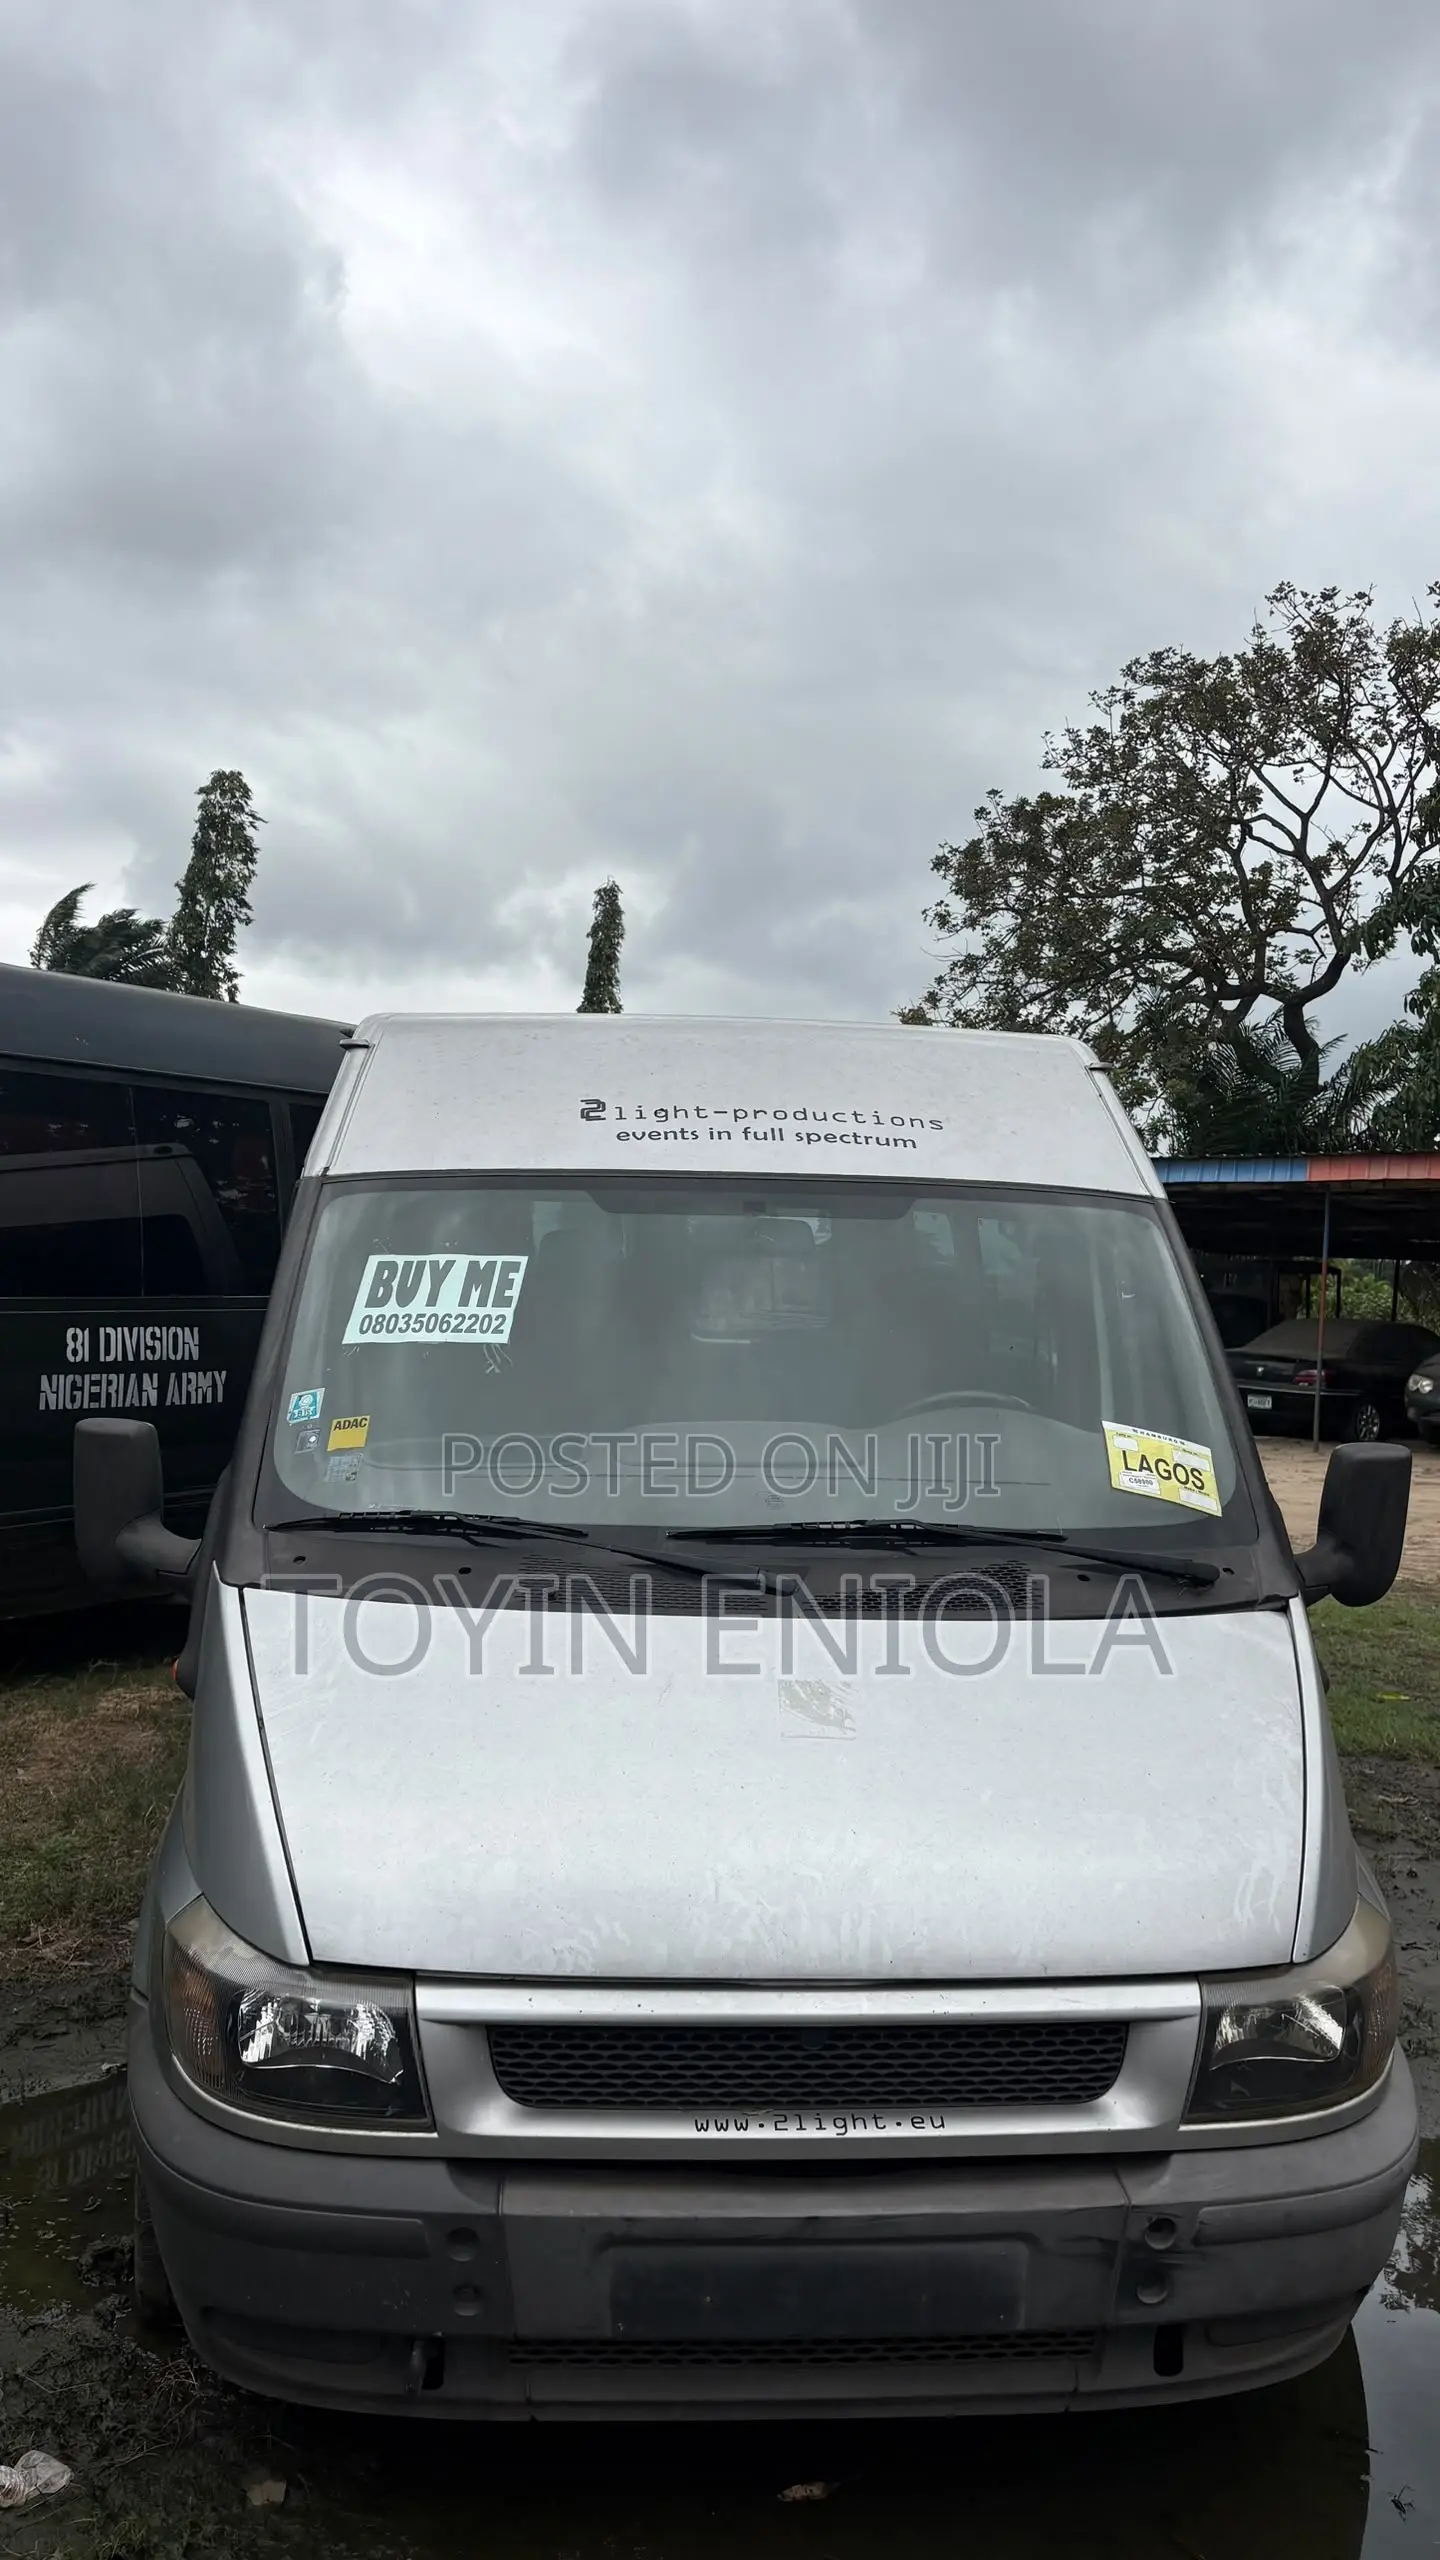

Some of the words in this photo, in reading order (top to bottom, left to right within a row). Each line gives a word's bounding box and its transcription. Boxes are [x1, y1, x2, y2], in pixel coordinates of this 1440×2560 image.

[616, 1127, 700, 1142] events
[709, 1126, 732, 1141] in
[742, 1126, 785, 1142] full
[795, 1129, 917, 1149] spectrum
[364, 1259, 457, 1308] BUY
[457, 1259, 522, 1308] ME
[358, 1313, 507, 1335] 08035062202
[99, 1326, 200, 1362] DIVISION
[39, 1372, 158, 1411] NIGERIAN
[165, 1370, 227, 1406] ARMY
[333, 1417, 368, 1431] ADAC
[1121, 1449, 1205, 1491] LAGOS
[694, 2113, 946, 2136] www.2light.eu
